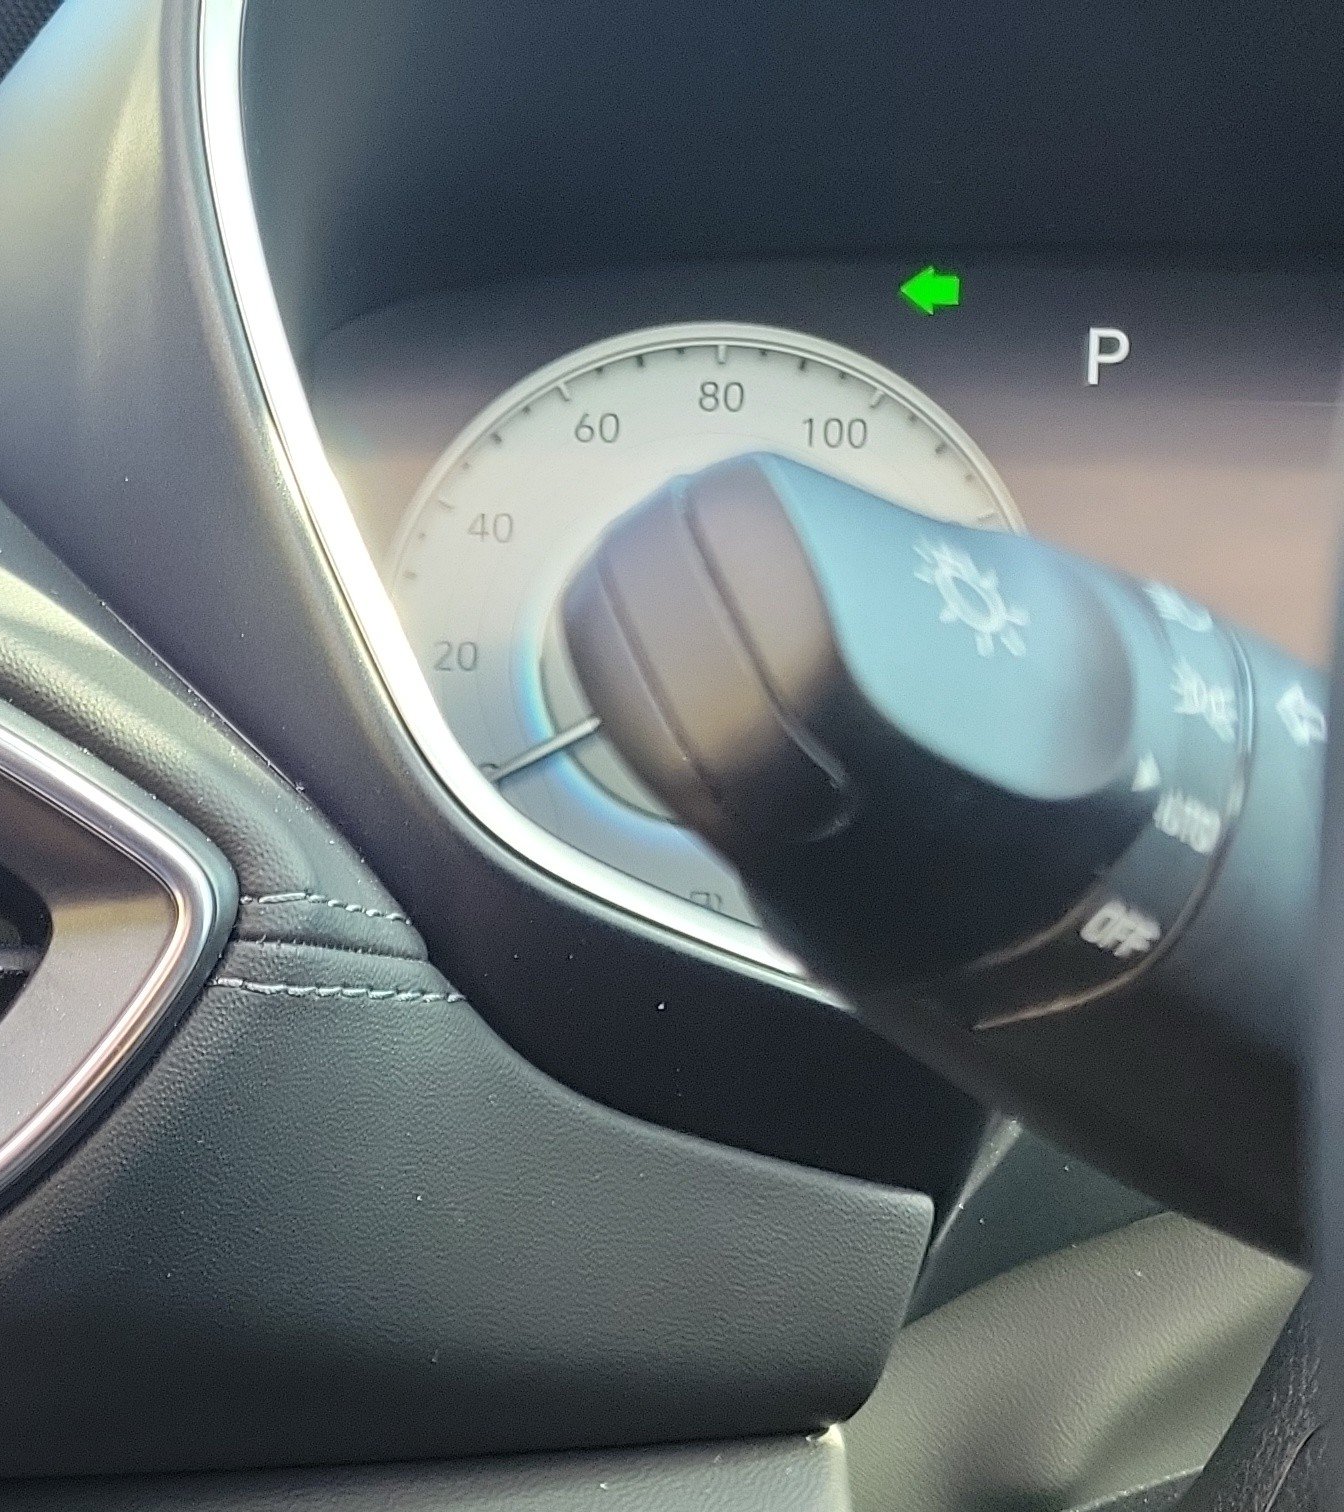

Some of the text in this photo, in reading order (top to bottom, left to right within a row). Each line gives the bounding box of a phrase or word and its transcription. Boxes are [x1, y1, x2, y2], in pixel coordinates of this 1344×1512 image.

[1088, 327, 1130, 385] P
[698, 381, 745, 413] 80
[574, 412, 620, 444] 60
[802, 416, 869, 449] 100
[467, 511, 514, 543] 40
[433, 640, 479, 672] 20
[1080, 899, 1161, 957] OFF
